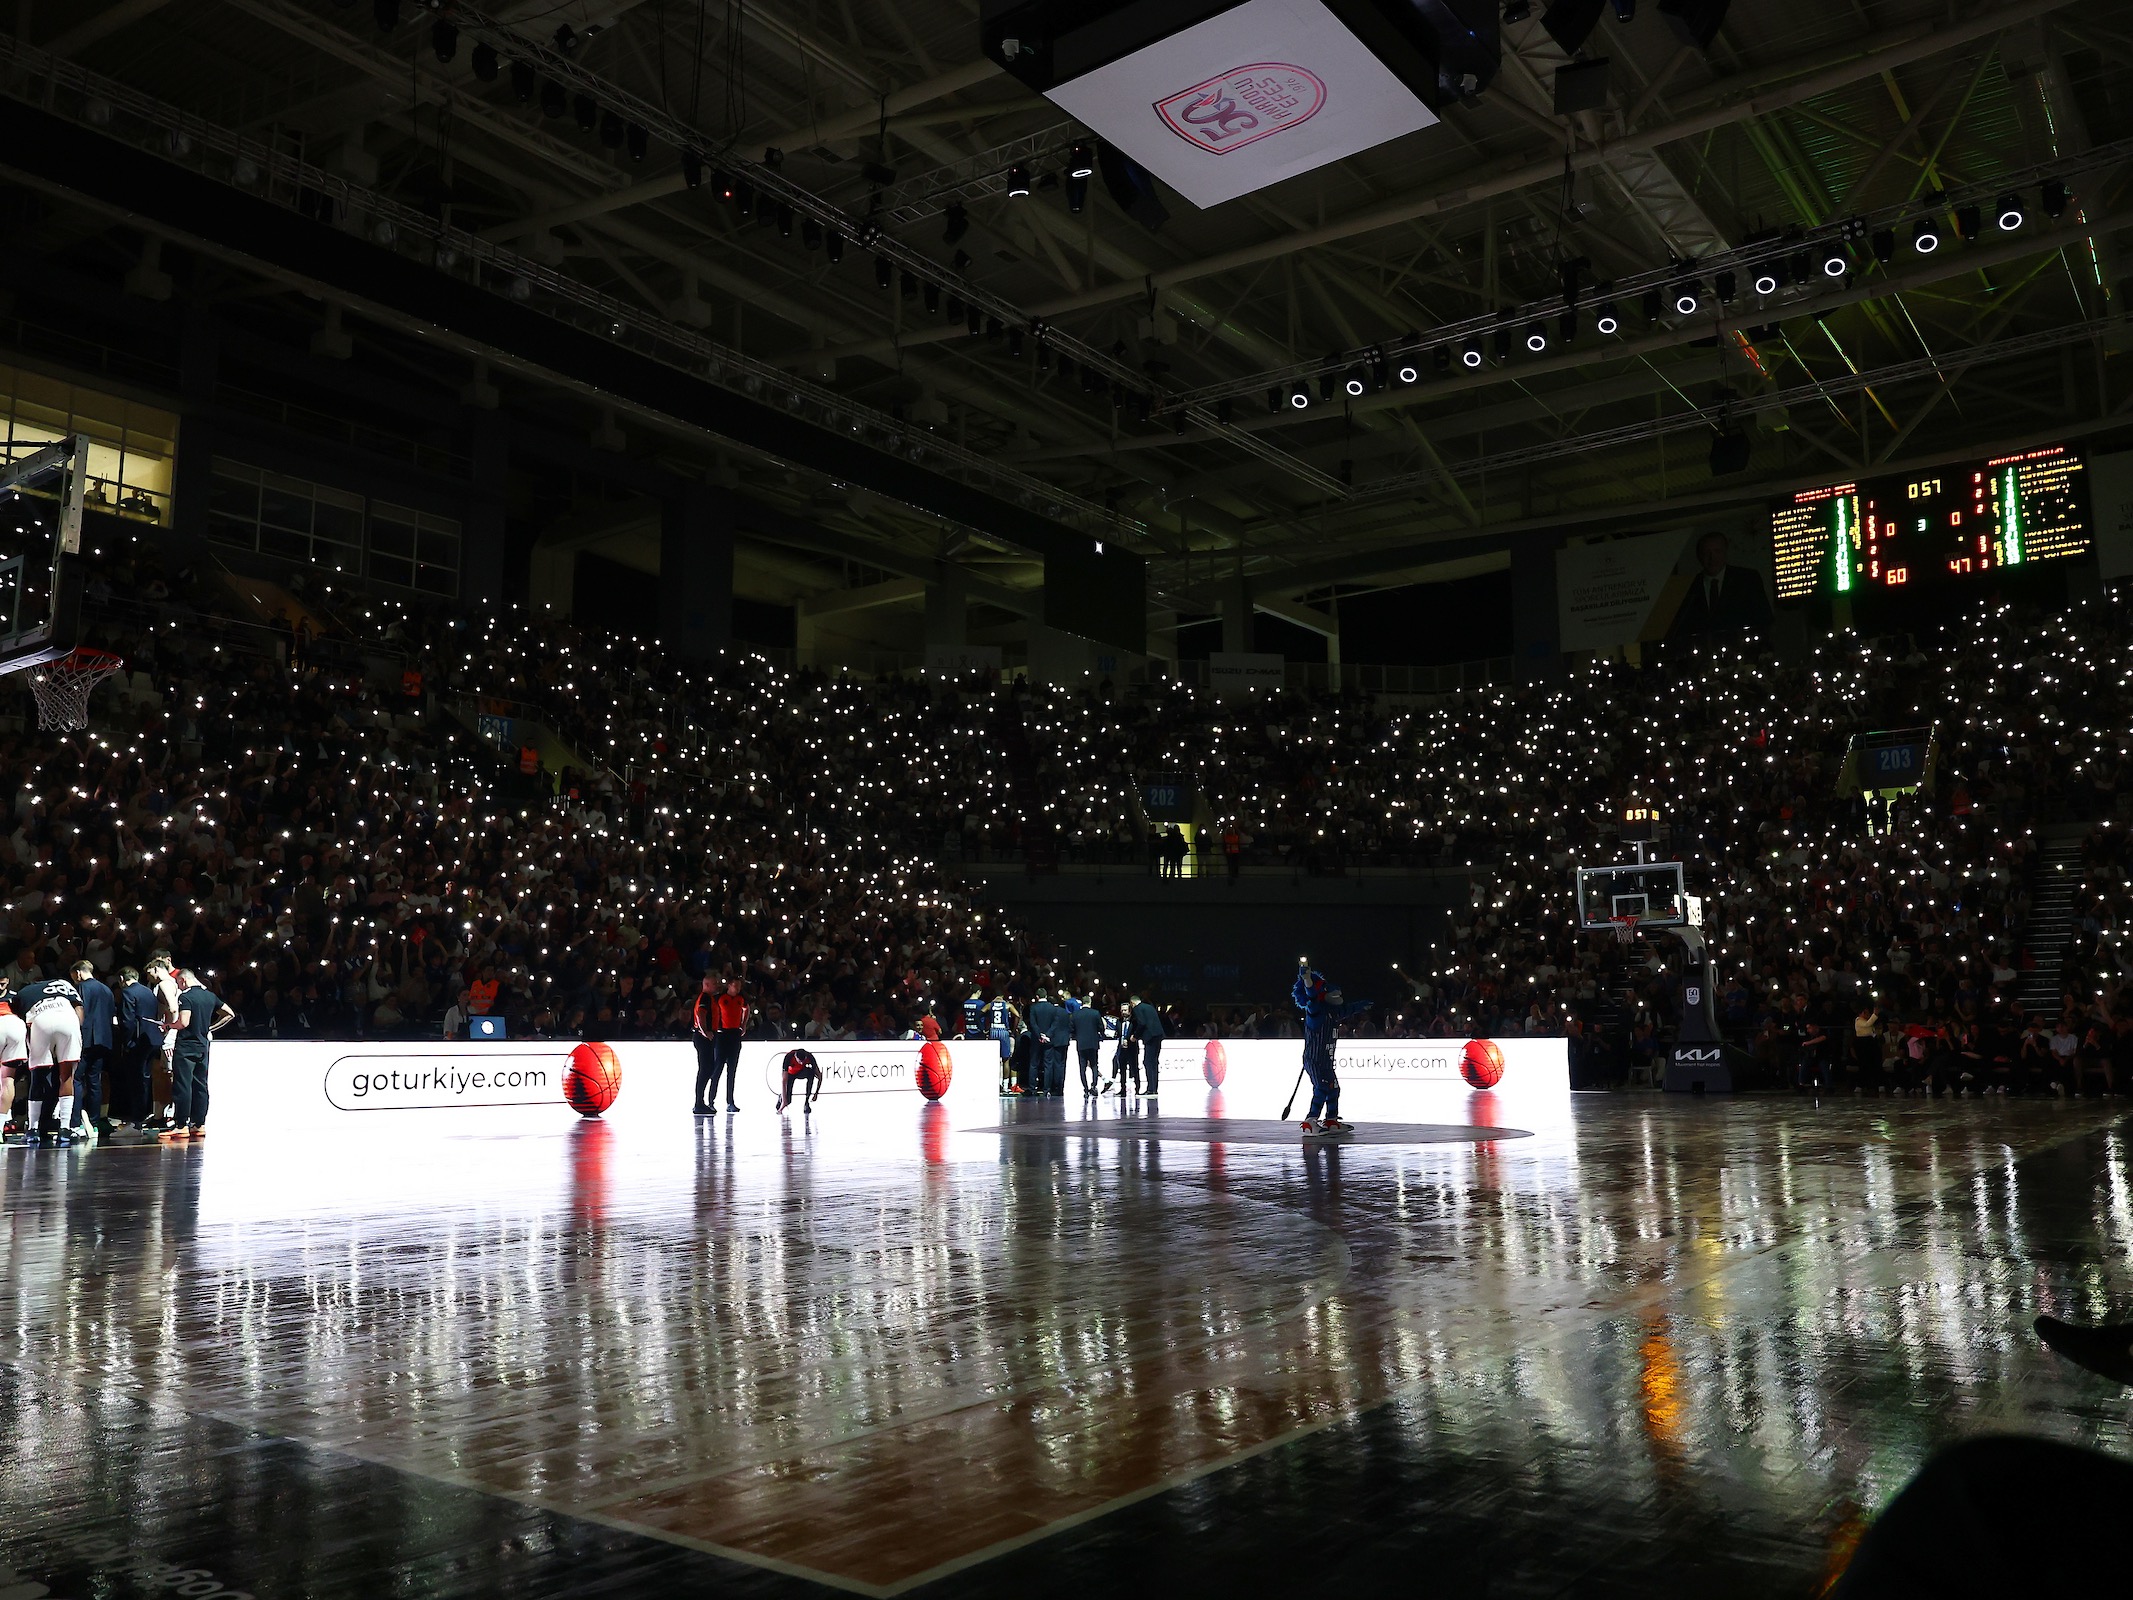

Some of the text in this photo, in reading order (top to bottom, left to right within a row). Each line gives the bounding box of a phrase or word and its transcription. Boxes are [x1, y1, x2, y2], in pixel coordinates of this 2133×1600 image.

[1233, 77, 1293, 121] ANADOLU
[1255, 77, 1299, 110] EFES
[1917, 518, 1927, 532] 3
[1951, 511, 1961, 525] 0
[1886, 522, 1896, 536] 0
[1950, 558, 1971, 574] 47
[1886, 568, 1907, 585] 60
[1097, 656, 1117, 671] 202
[1211, 667, 1242, 675] ISUZU
[1880, 748, 1912, 771] 203
[1151, 788, 1175, 806] 202
[1674, 1048, 1721, 1061] KIA
[352, 1066, 547, 1097] goturkiye.com
